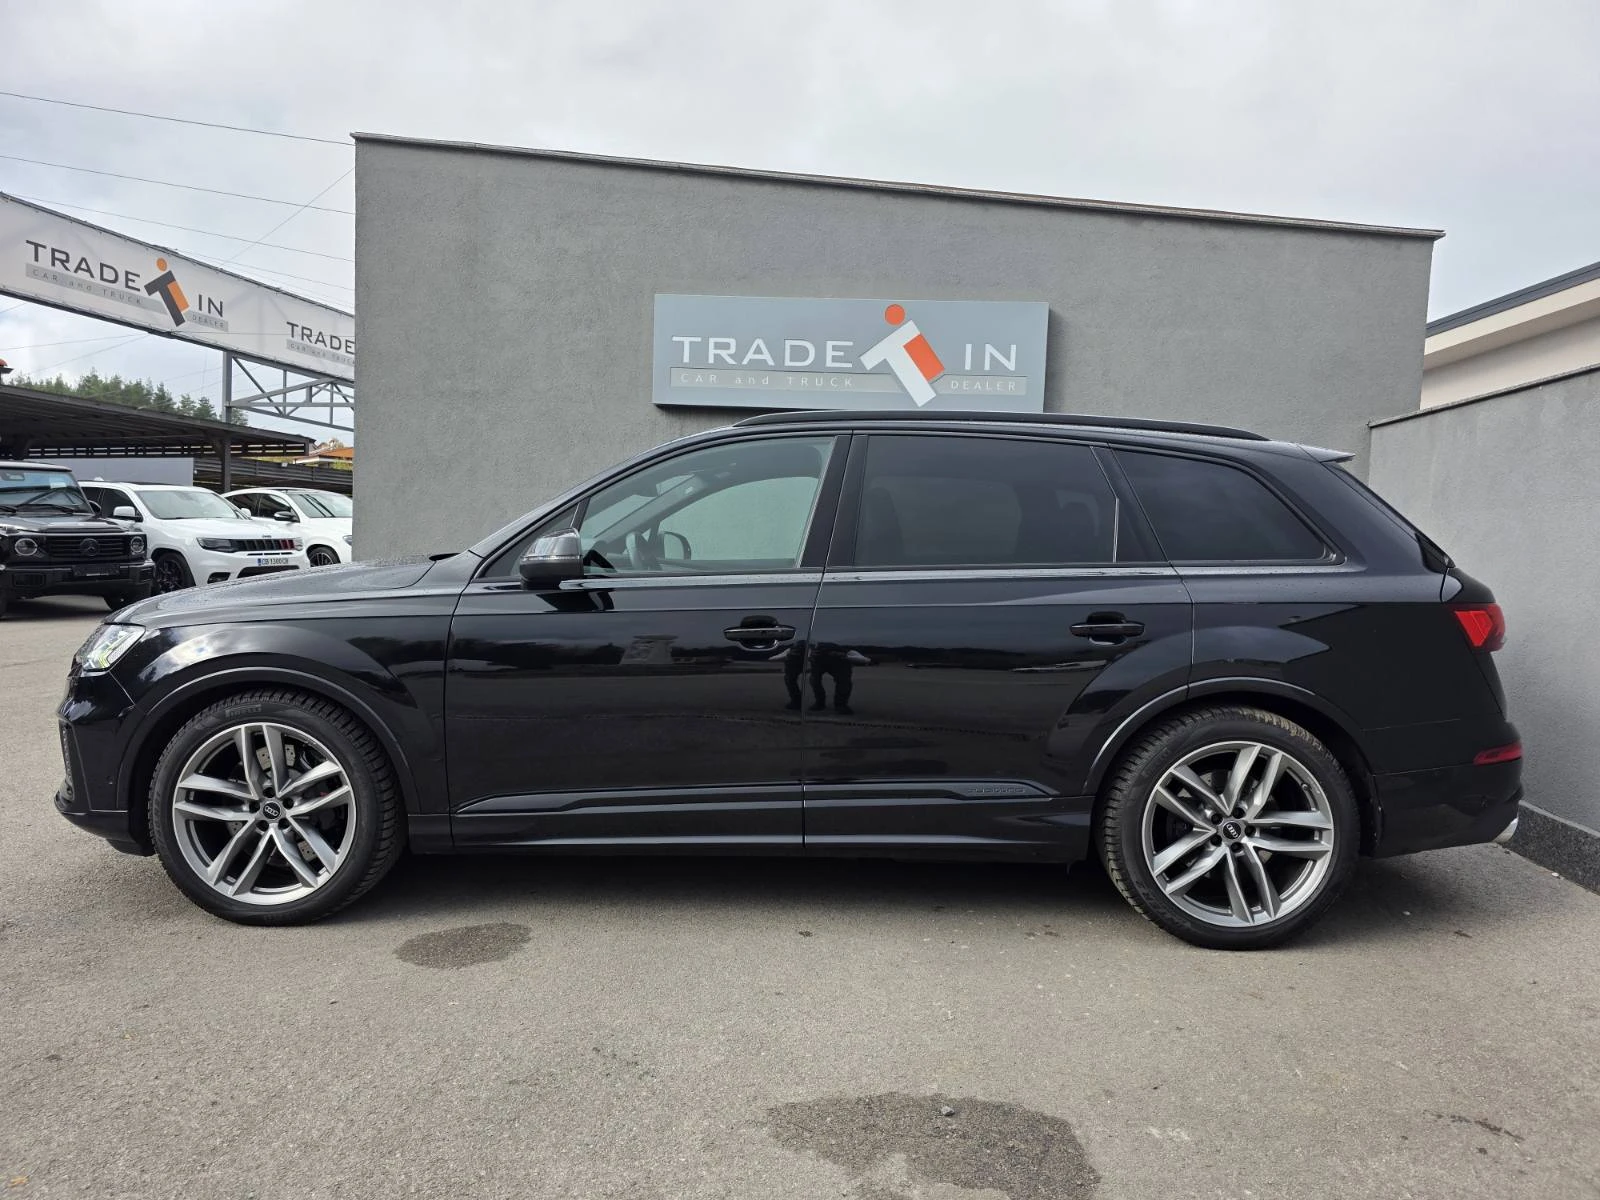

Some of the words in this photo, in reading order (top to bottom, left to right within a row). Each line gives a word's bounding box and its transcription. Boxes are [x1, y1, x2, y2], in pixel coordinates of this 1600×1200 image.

[26, 239, 141, 292] TRADE
[198, 294, 224, 317] IN
[32, 269, 59, 281] CAR
[103, 288, 142, 305] TRUCK
[286, 321, 355, 355] TRADE
[672, 336, 854, 368] TRADE
[964, 343, 1016, 371] IN
[680, 373, 718, 385] CAR
[735, 375, 769, 386] and
[787, 376, 853, 387] TRUCK
[951, 380, 1017, 392] DEALER
